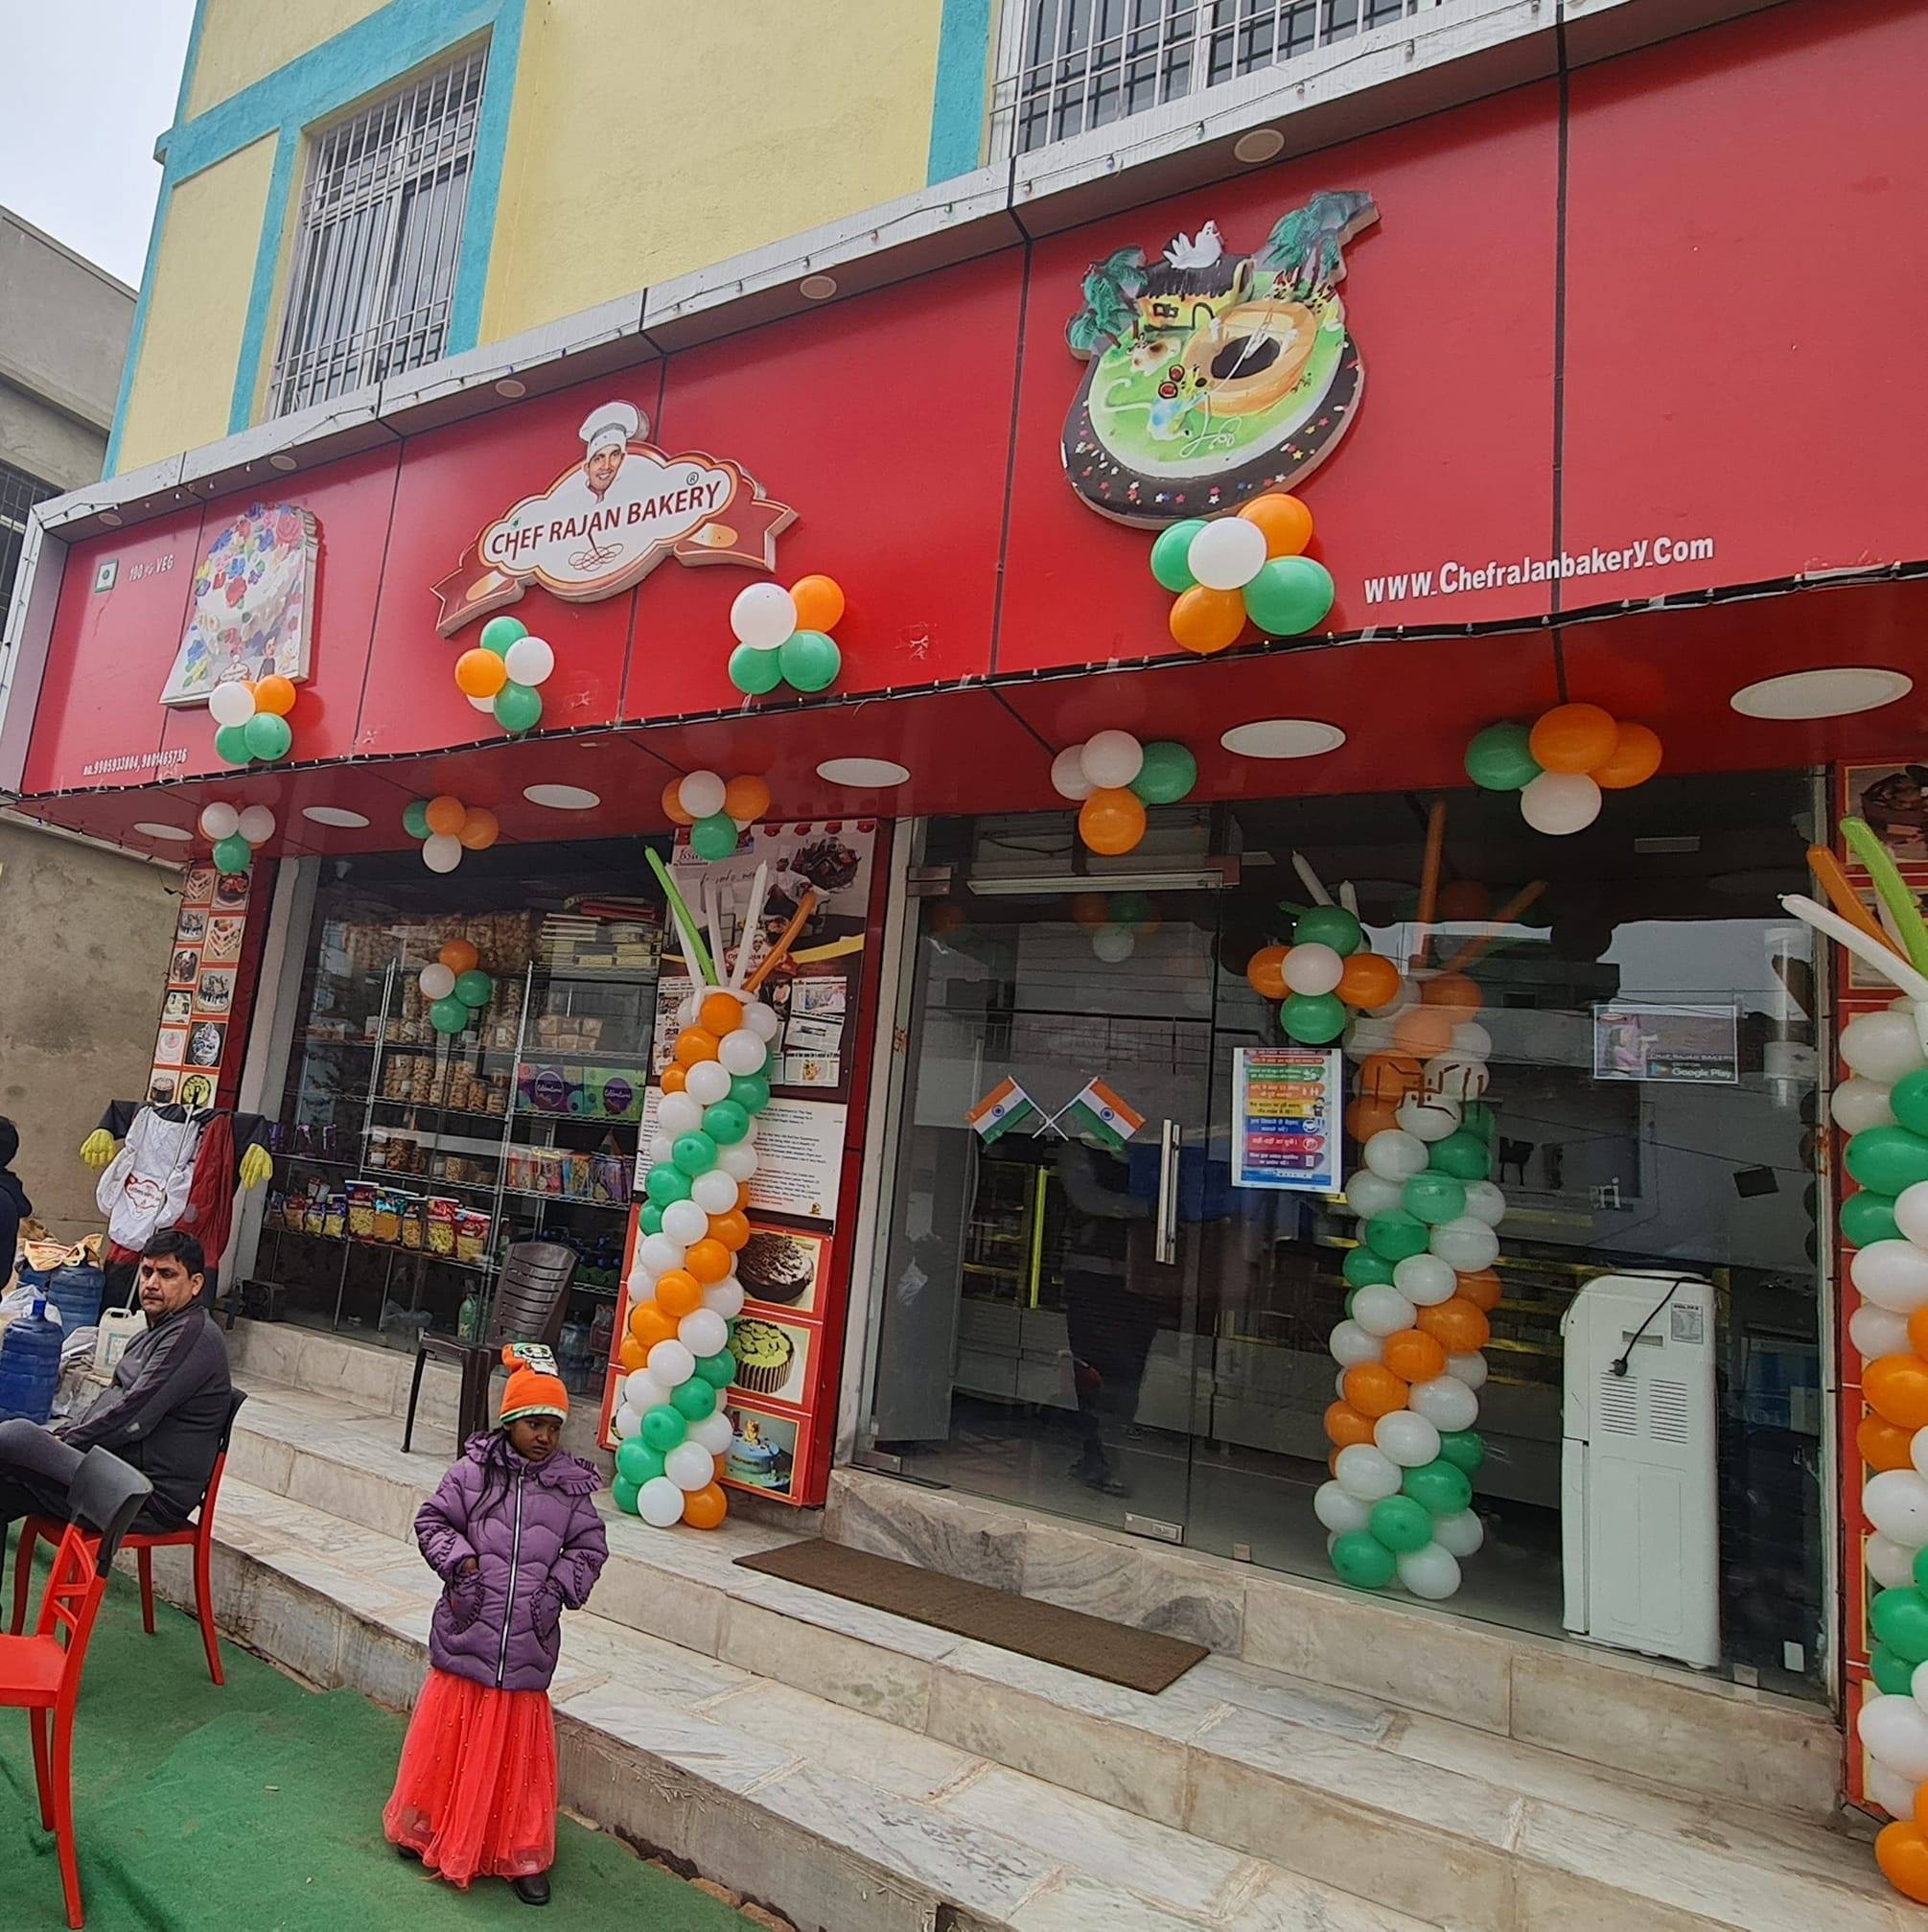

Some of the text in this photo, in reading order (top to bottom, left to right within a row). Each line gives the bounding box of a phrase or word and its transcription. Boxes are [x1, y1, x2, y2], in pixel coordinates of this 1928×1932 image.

[491, 480, 722, 561] CHEF RAJAN BAKERY
[156, 554, 174, 573] VEG
[1671, 1067, 1732, 1080] Google Play
